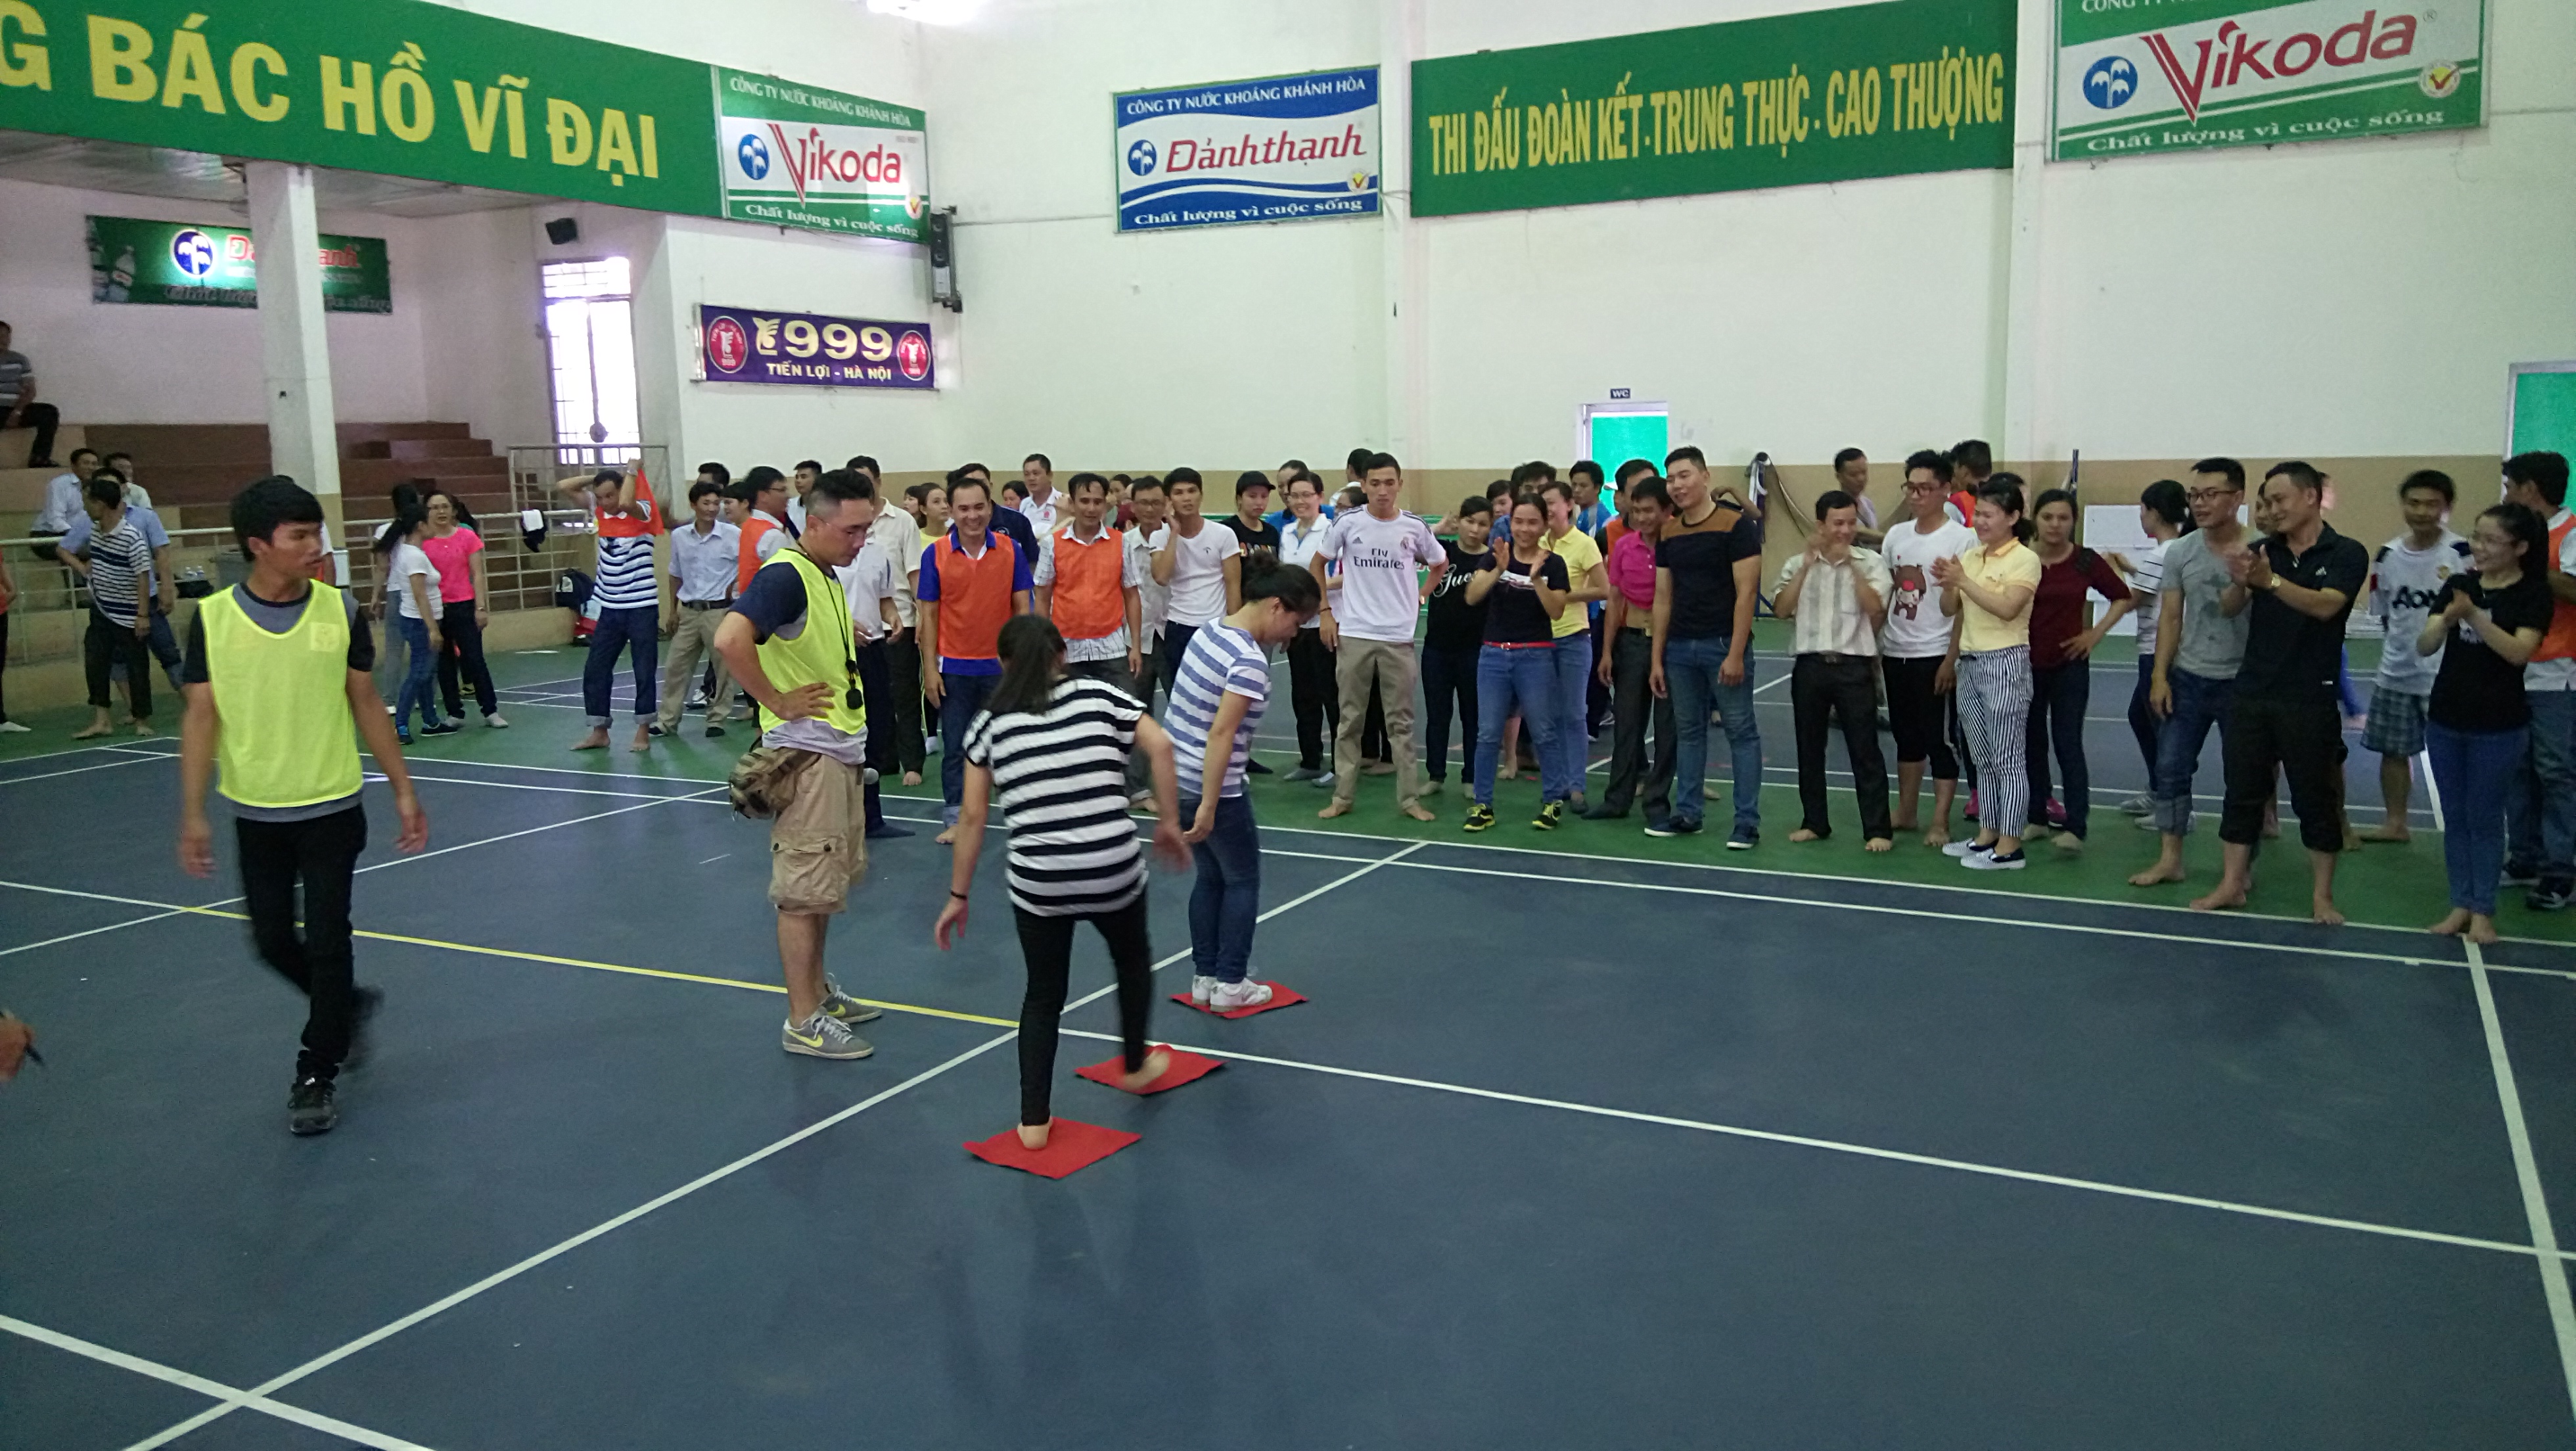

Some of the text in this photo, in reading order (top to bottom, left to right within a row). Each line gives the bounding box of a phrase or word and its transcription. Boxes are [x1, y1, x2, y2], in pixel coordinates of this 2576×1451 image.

[2139, 9, 2417, 126] Vikoda
[87, 13, 289, 122] BÁC
[320, 41, 434, 143] HỒ
[454, 75, 529, 158] VĨ
[547, 97, 658, 187] ĐẠI
[729, 75, 764, 97] CÔNG
[764, 84, 779, 99] TY
[1126, 99, 1164, 115] CÔNG
[1166, 98, 1183, 111] TY
[1224, 85, 1281, 106] KHOÁNG
[1283, 80, 1333, 99] KHÁNH
[1335, 76, 1366, 93] HÒA
[1429, 113, 1467, 175] THI
[1474, 86, 1520, 172] ĐẤU
[1527, 88, 1591, 168] ĐOÀN
[1742, 63, 1810, 158] THỰC
[1826, 66, 1881, 138] CAO
[1889, 45, 2004, 140] THƯỢNG
[2087, 109, 2445, 152] Chất lượng vì cuộc sống
[767, 123, 902, 209] Vikoda
[745, 204, 783, 218] Chất
[833, 216, 848, 227] vì
[1134, 198, 1364, 225] Chất lượng vì cuộc sống
[766, 360, 802, 377] TIẾN
[843, 365, 864, 379] HÀ
[867, 365, 892, 382] NỘI
[1354, 556, 1404, 569] Emirates
[1371, 548, 1388, 557] Fly
